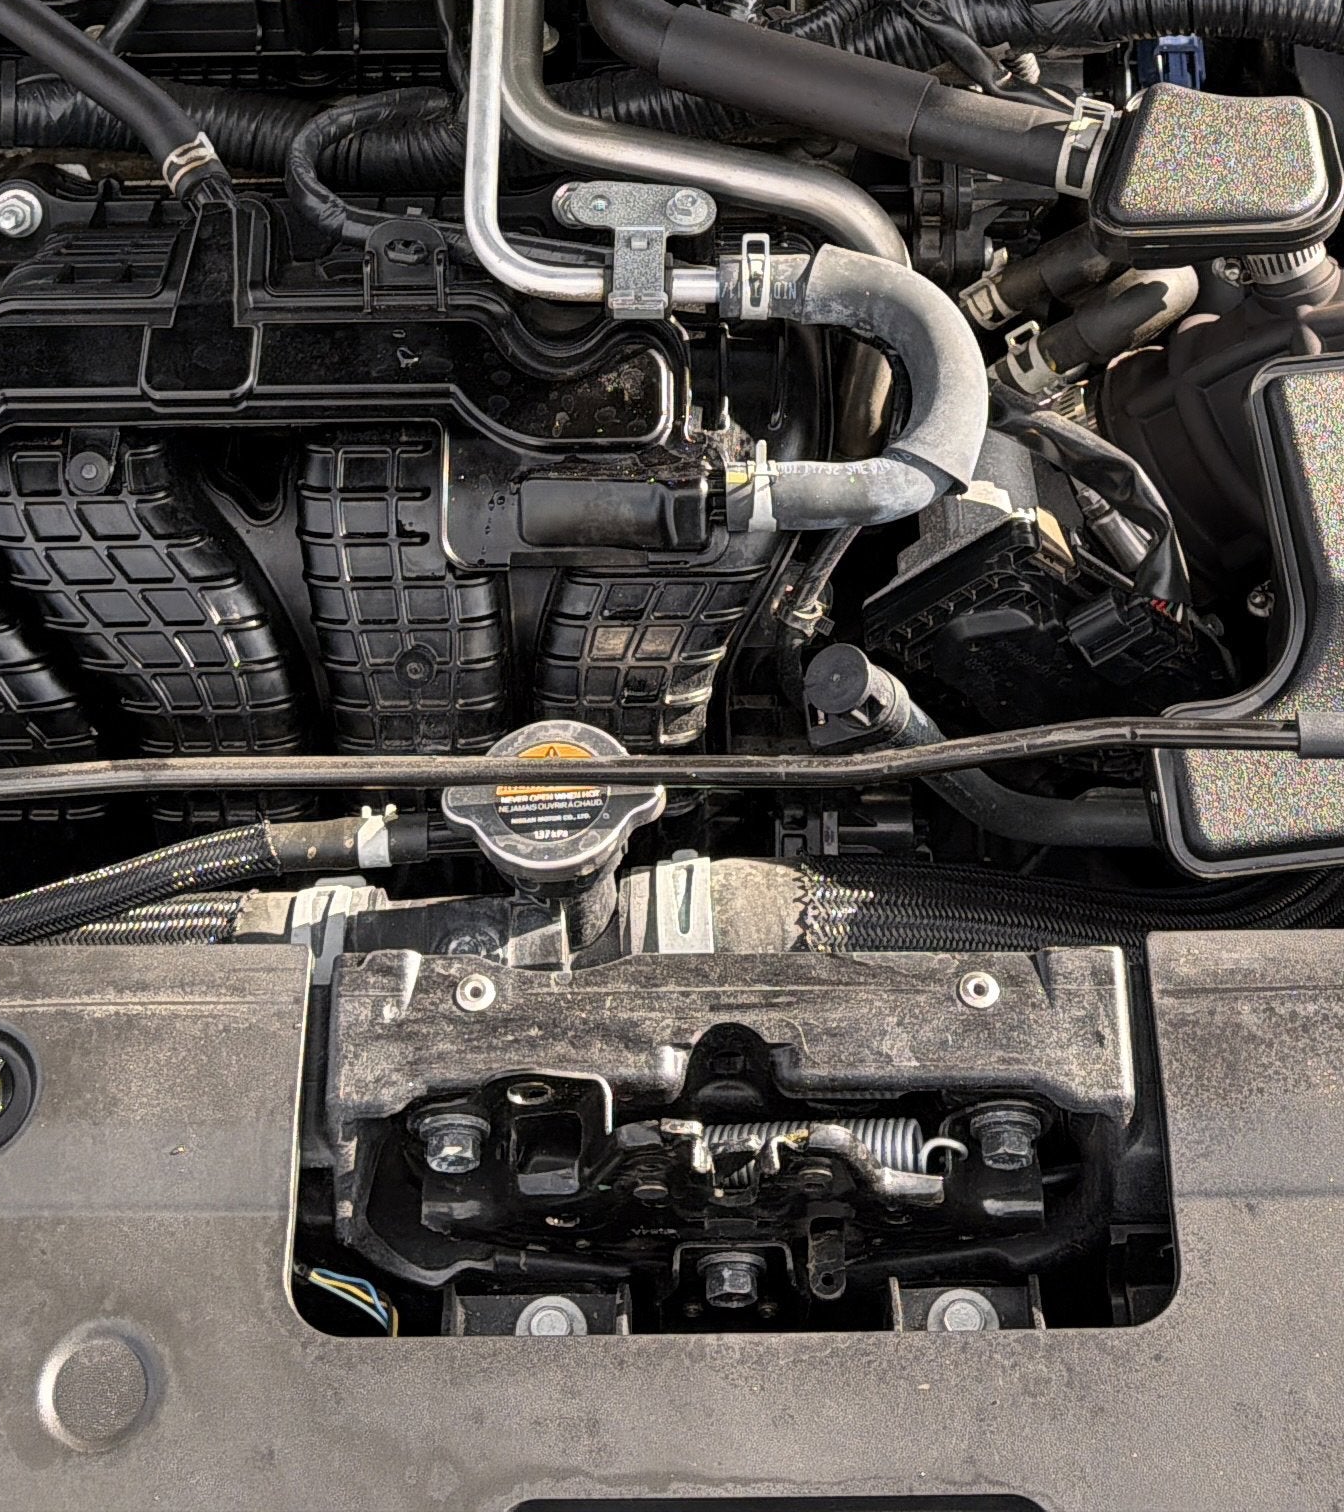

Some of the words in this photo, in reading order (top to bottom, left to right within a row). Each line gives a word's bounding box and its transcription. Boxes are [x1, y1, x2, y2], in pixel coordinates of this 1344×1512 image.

[500, 795, 528, 804] NEVER
[529, 793, 554, 802] OPEN
[554, 791, 581, 800] WHEN
[498, 805, 510, 813] NE
[510, 803, 537, 812] JAMAIS
[538, 801, 567, 810] OUVRIR
